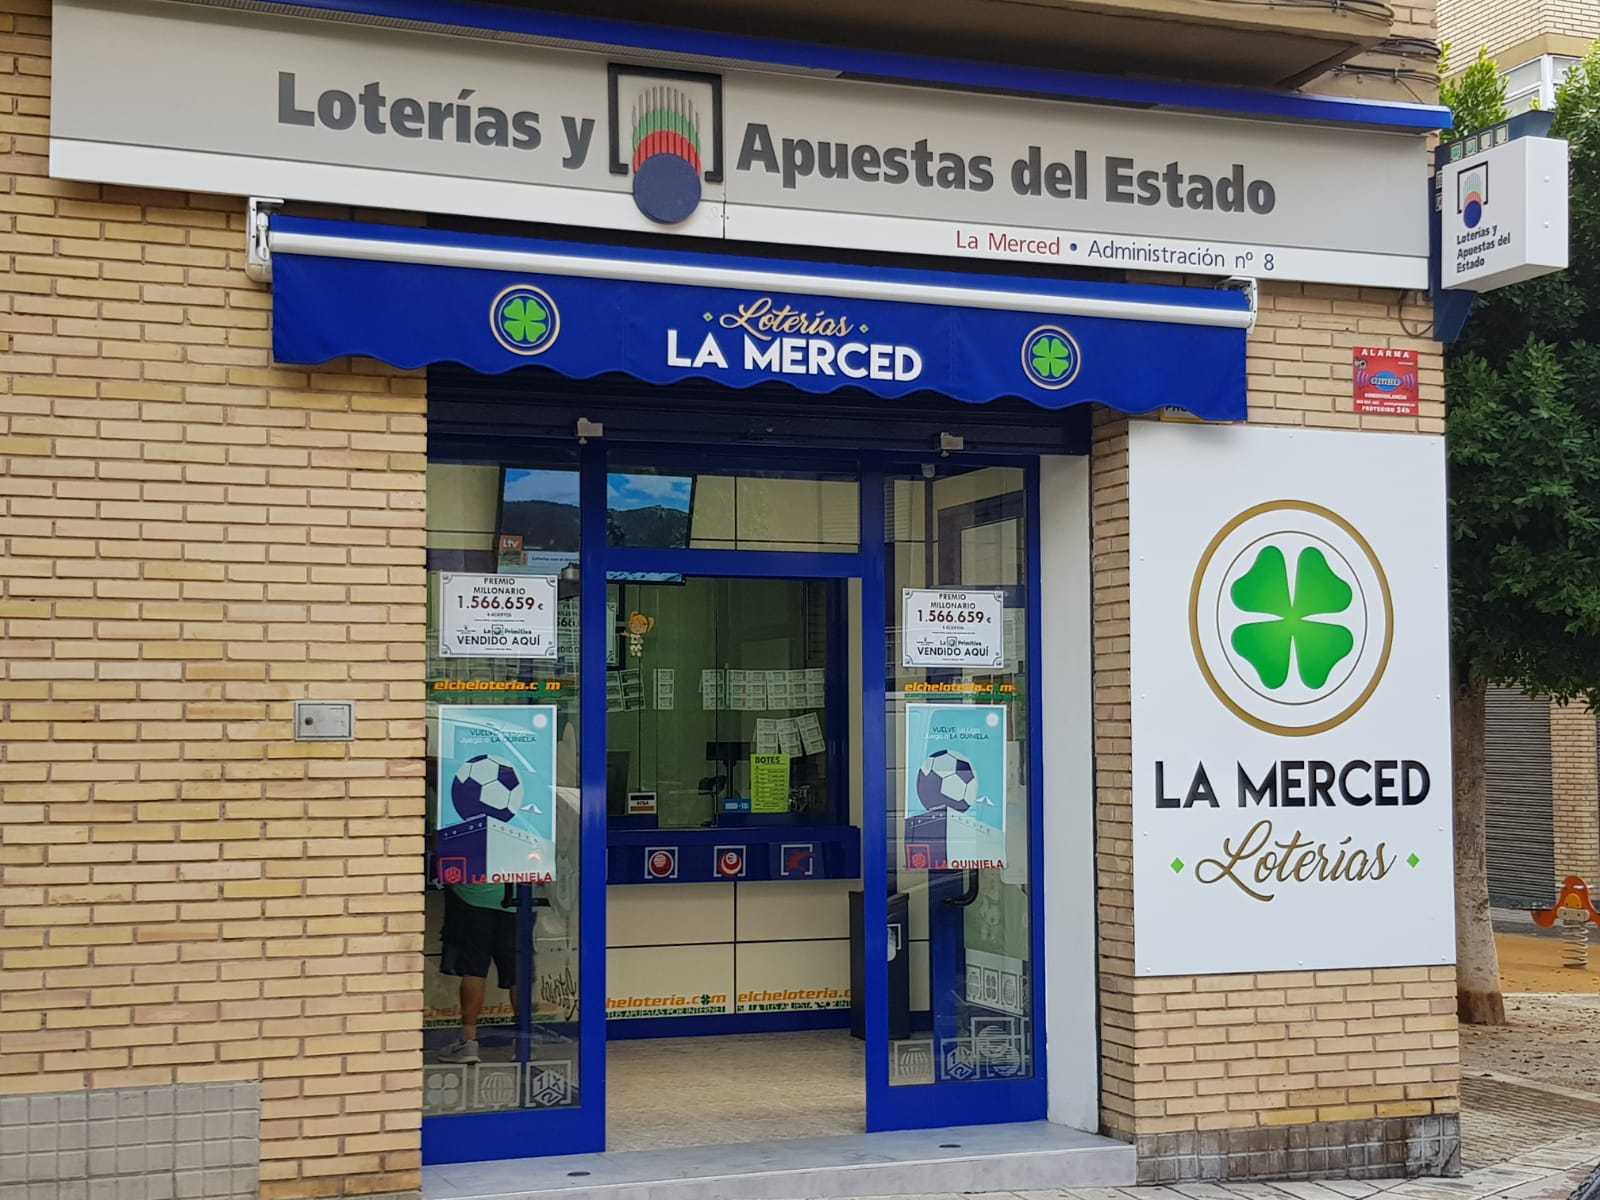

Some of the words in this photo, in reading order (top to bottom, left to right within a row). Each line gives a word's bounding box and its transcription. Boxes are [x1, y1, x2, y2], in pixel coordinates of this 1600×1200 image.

[278, 71, 542, 150] Loterías
[560, 115, 596, 170] y
[735, 122, 995, 193] Apuestas
[1010, 145, 1088, 201] del
[1104, 155, 1276, 215] Estado
[1492, 224, 1498, 237] y
[956, 230, 979, 250] La
[988, 232, 1060, 256] Merced
[1088, 239, 1225, 268] Administración
[1235, 251, 1254, 269] nº
[1263, 253, 1275, 272] 8
[1456, 240, 1496, 260] Apuestas
[1498, 232, 1511, 247] del
[1456, 256, 1486, 273] Estado
[719, 297, 854, 341] Loterías
[667, 328, 729, 370] LA
[743, 334, 923, 383] MERCED
[1361, 348, 1410, 359] ALARMA
[483, 577, 516, 585] PREMIO
[473, 586, 526, 595] MILLONARIO
[938, 593, 967, 601] PREMIO
[457, 595, 535, 610] 1.566.659
[930, 602, 976, 610] MILLONARIO
[917, 609, 985, 624] 1.566.659
[457, 635, 508, 646] VENDIDO
[511, 634, 540, 647] AQUÍ
[917, 646, 961, 656] VENDIDO
[964, 645, 989, 657] AQUÍ
[1155, 760, 1221, 809] LA
[1237, 759, 1431, 808] MERCED
[951, 859, 1005, 870] QUINIELA
[1194, 819, 1397, 902] Loterías
[491, 871, 553, 885] QUINIELA
